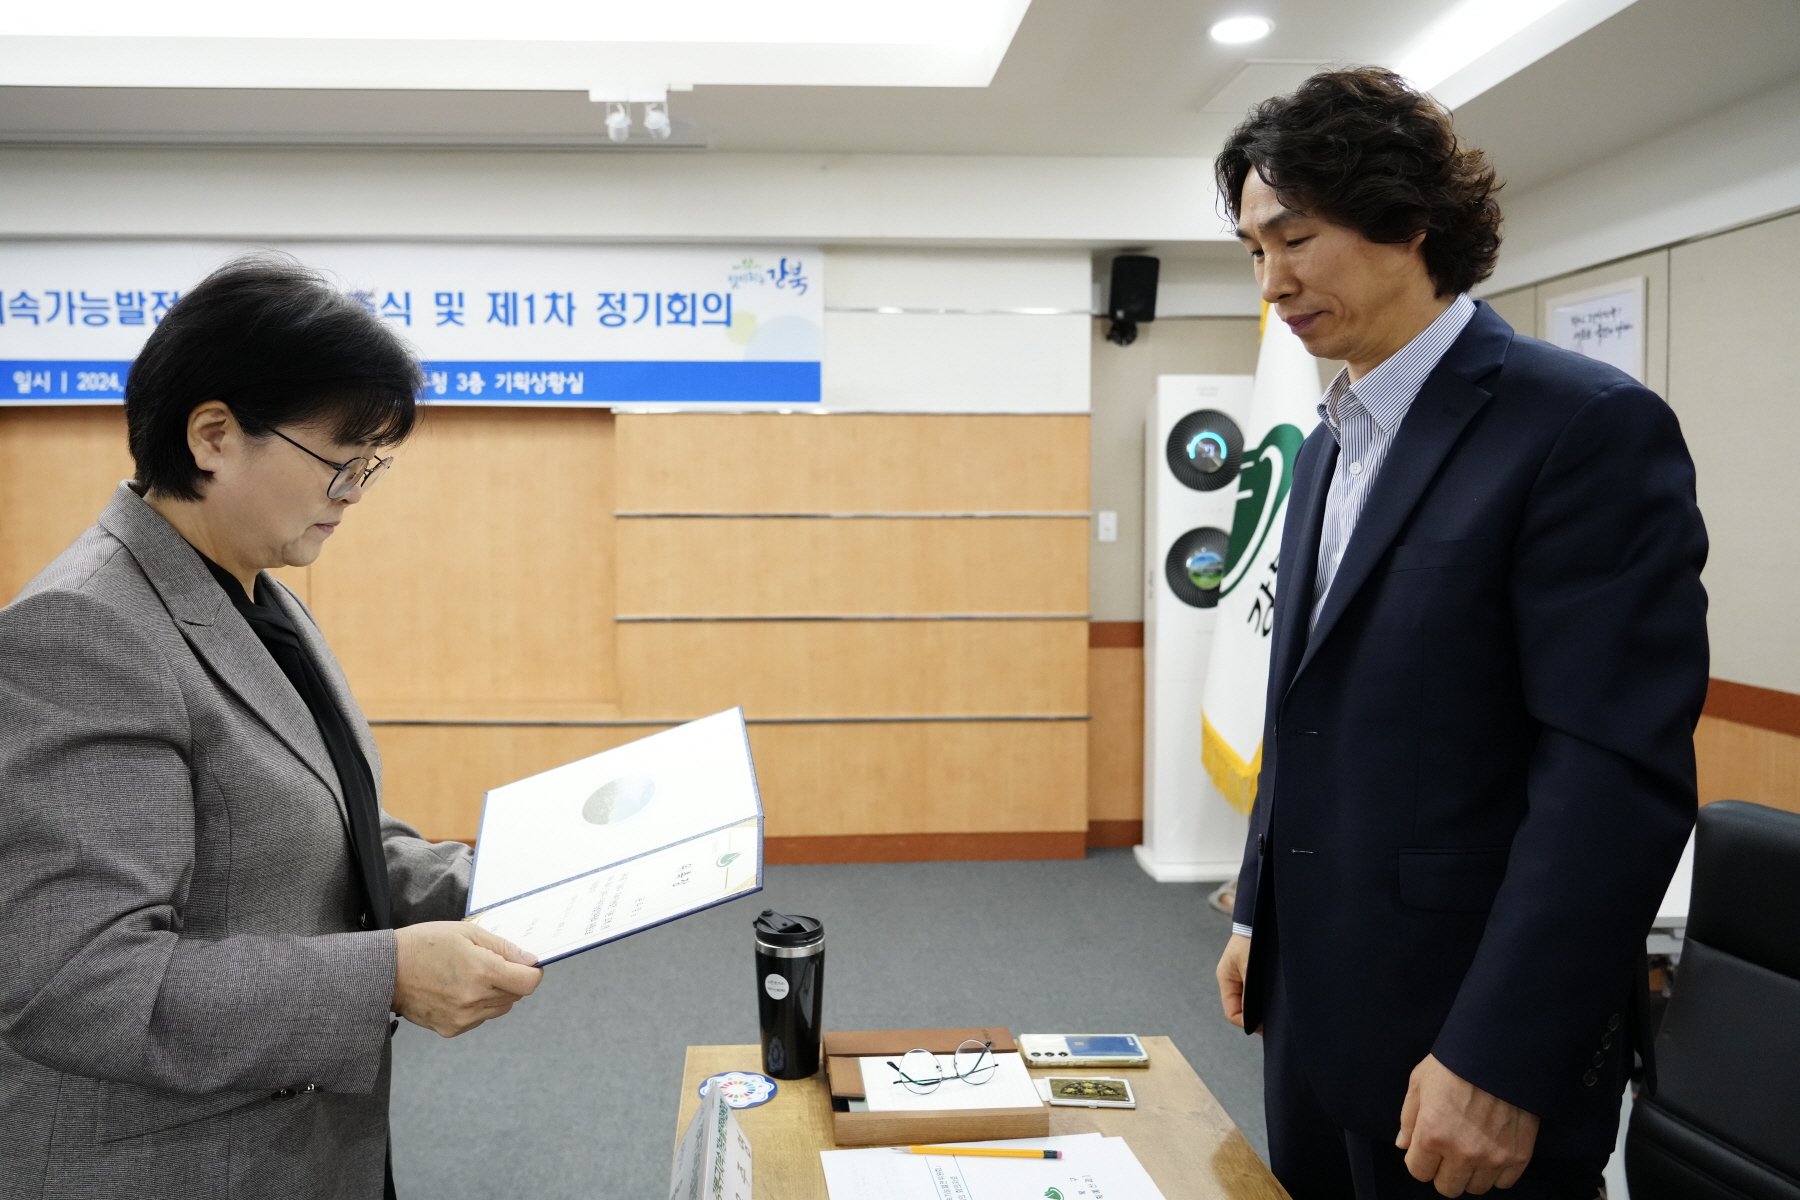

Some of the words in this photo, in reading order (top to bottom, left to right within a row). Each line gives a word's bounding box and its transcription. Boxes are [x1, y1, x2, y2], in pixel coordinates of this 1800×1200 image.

[766, 258, 807, 295] 강북
[434, 291, 465, 327] 및
[486, 291, 576, 327] 제1차
[597, 292, 732, 328] 정기회의
[12, 370, 51, 394] 일시
[456, 371, 486, 395] 3층
[494, 371, 584, 395] 기획상황실
